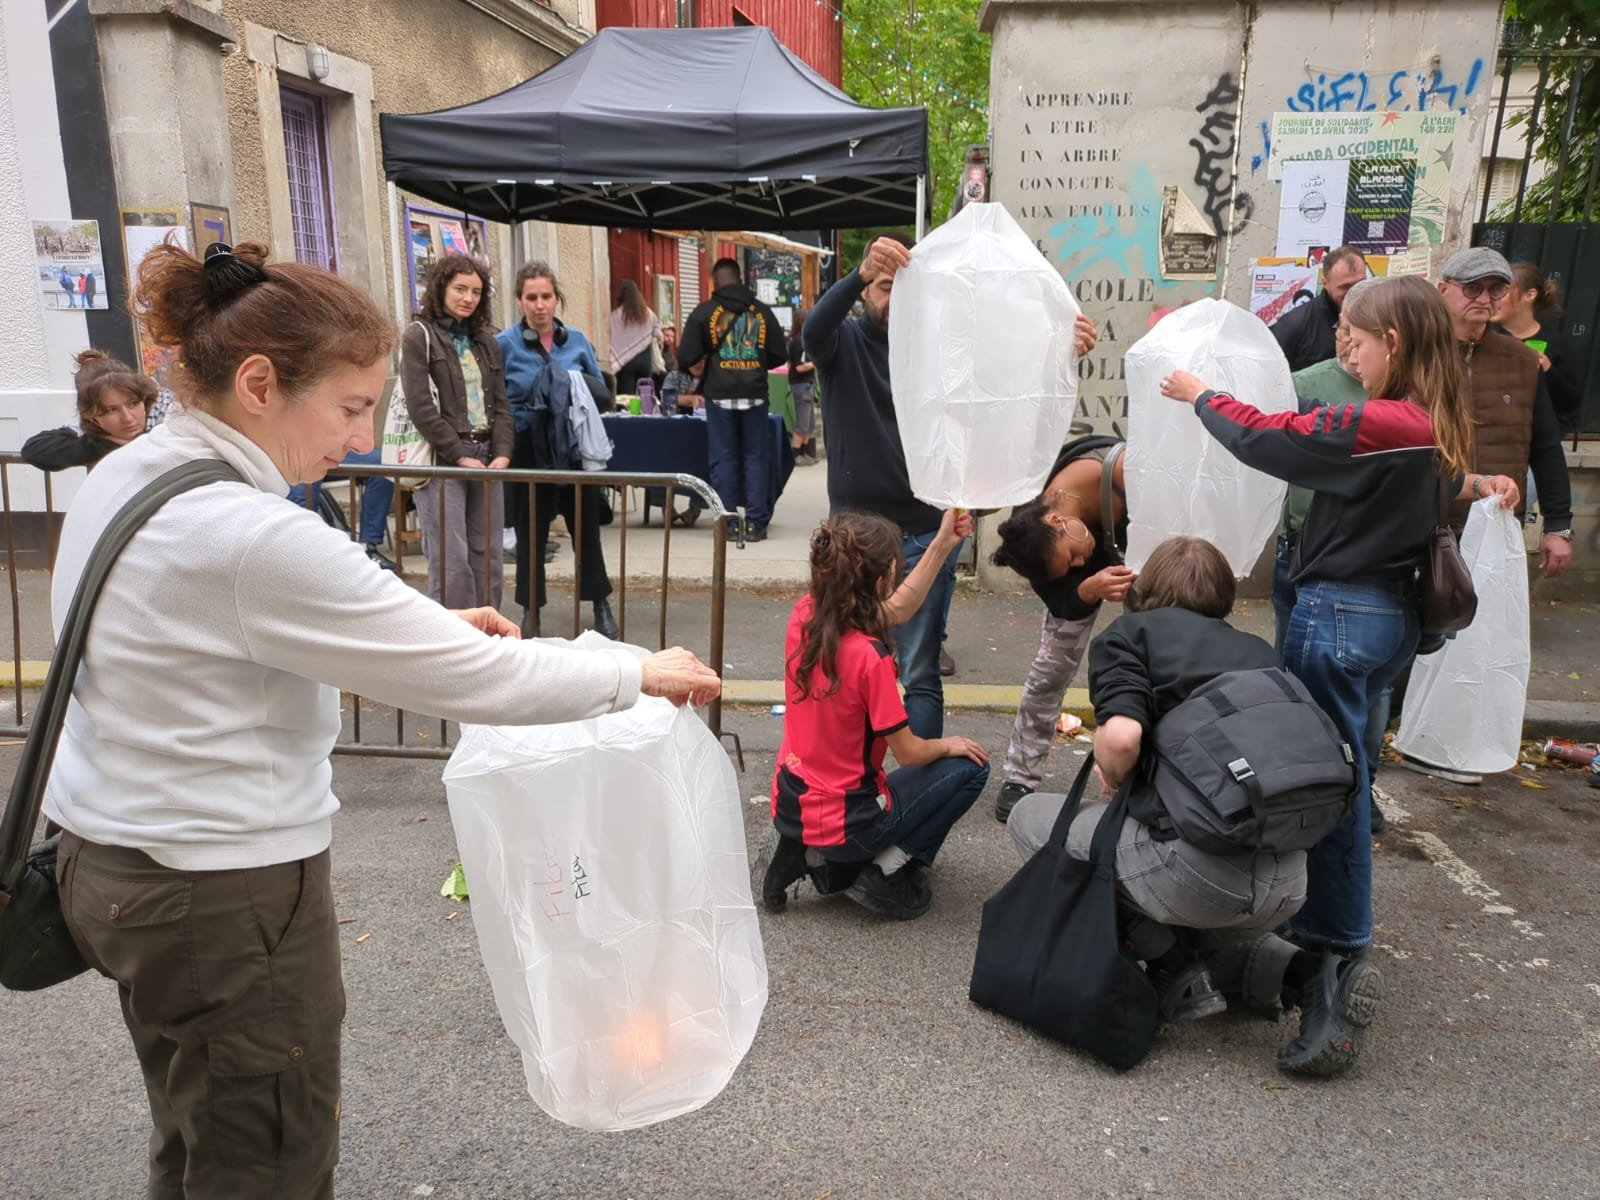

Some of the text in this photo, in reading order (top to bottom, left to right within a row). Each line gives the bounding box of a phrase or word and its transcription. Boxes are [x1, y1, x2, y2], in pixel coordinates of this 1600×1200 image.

[1022, 91, 1134, 107] APPRENDRE
[1021, 120, 1098, 135] A ETRE
[1278, 126, 1308, 135] SAMEDI
[1321, 126, 1346, 135] AVRIL
[1347, 126, 1369, 135] 2025
[1337, 137, 1419, 158] OCCIDENTAL,
[1020, 148, 1122, 164] UN ARBRE
[1019, 176, 1115, 191] CONNECTE
[1016, 202, 1151, 219] AUX ETOILES
[1069, 278, 1154, 303] COLE
